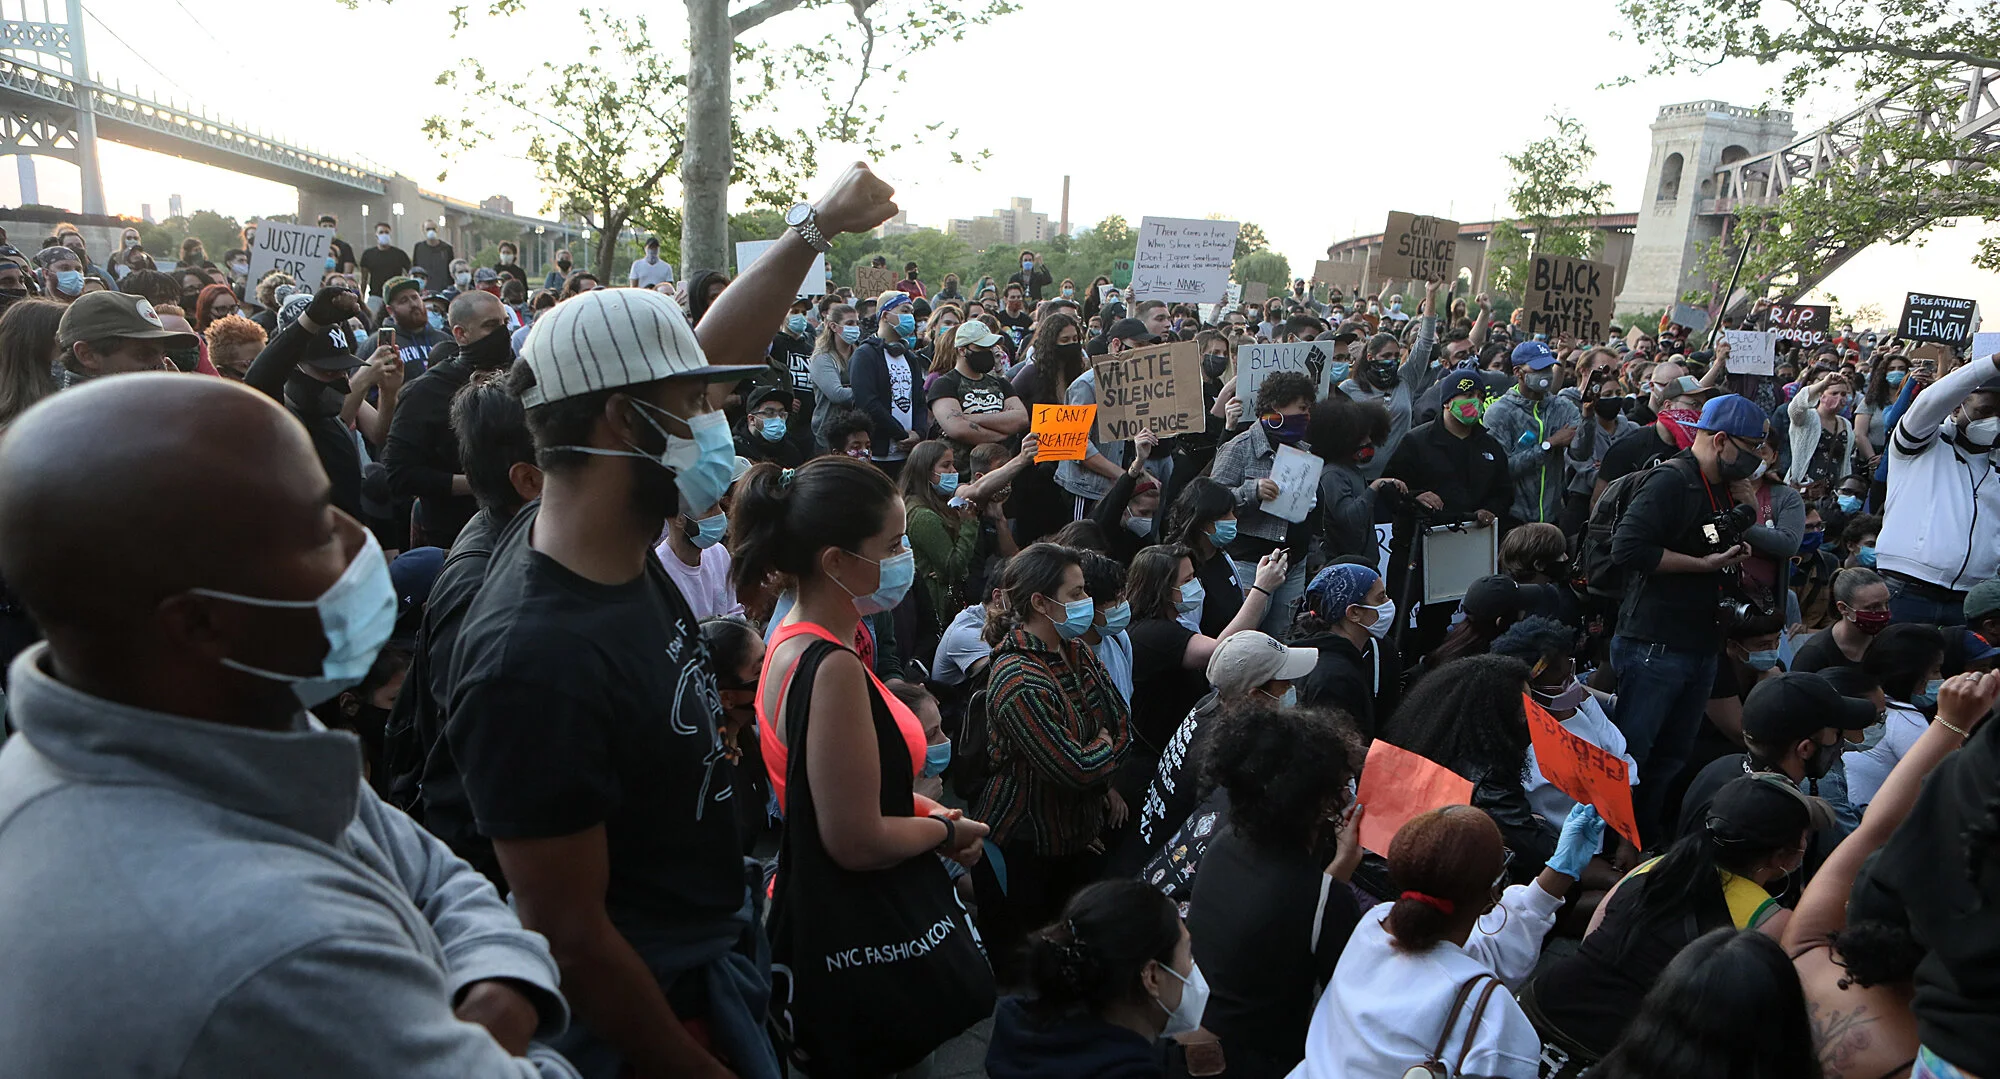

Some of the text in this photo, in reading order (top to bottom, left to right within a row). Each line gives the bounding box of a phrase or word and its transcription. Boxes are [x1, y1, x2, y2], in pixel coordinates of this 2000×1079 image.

[1411, 216, 1440, 238] CAN'T
[260, 227, 325, 258] JUSTICE
[1397, 232, 1456, 261] SILENCE
[274, 258, 306, 282] FOR
[859, 266, 886, 281] BLACK
[1115, 261, 1129, 270] NO
[1177, 279, 1206, 293] NAMES
[1534, 258, 1600, 297] BLACK
[1909, 294, 1971, 309] BREATHING
[1930, 309, 1945, 320] IN
[1529, 311, 1600, 342] MATTER
[1908, 317, 1965, 341] HEAVEN
[400, 346, 420, 363] NEW
[1251, 348, 1302, 370] BLACK
[1094, 353, 1173, 391] WHITE
[1103, 380, 1175, 408] SILENCE
[1039, 408, 1051, 424] I
[826, 915, 955, 972] NYC FASHION ICON
